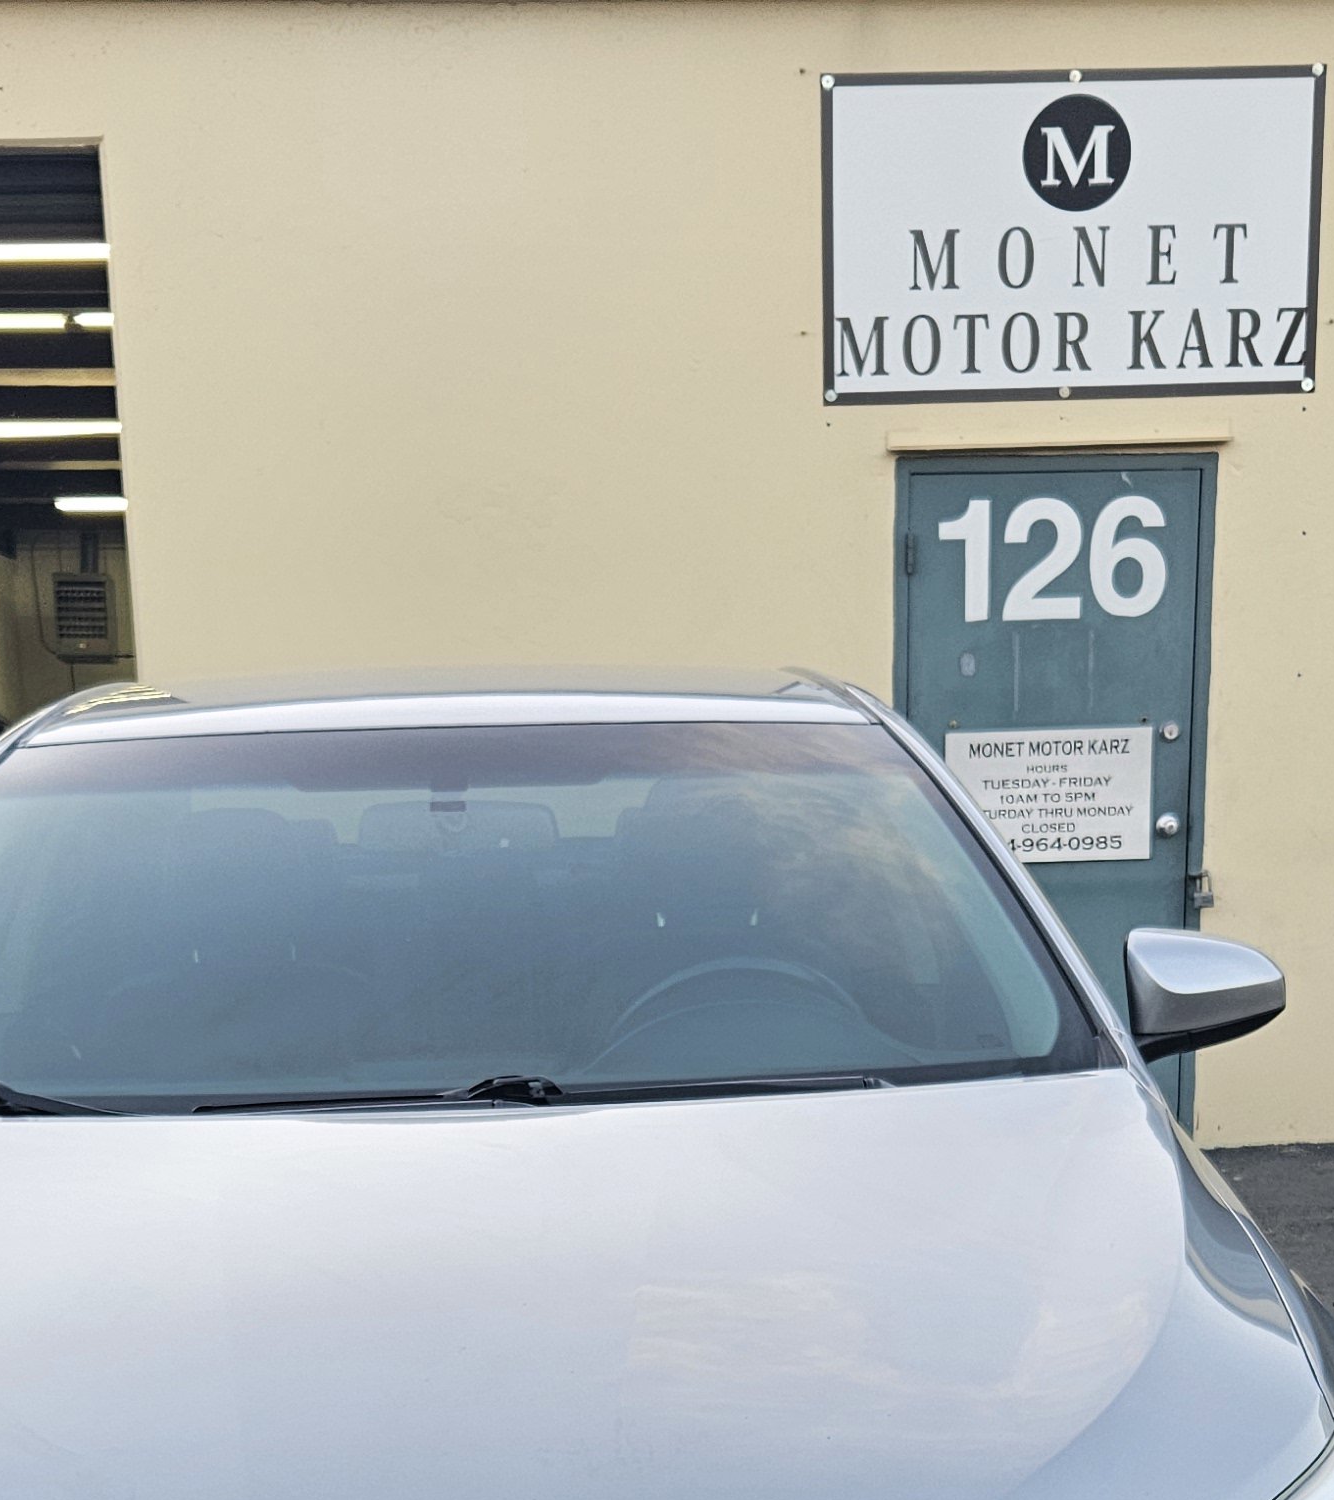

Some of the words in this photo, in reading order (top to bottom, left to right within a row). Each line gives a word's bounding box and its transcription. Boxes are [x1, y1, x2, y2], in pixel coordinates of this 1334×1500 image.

[1040, 125, 1115, 187] M
[909, 223, 1248, 291] MONET
[835, 312, 1091, 377] MOTOR
[1127, 306, 1309, 370] KARZ
[938, 495, 1168, 622] 126
[969, 742, 1024, 759] MONET
[1028, 740, 1083, 757] MOTOR
[1088, 739, 1131, 755] KARZ
[1027, 764, 1068, 774] HOURS
[1000, 794, 1037, 804] 10AM
[1042, 793, 1061, 803] TO
[1065, 792, 1096, 802] 5PM
[982, 809, 1033, 820] TURDAY
[1038, 807, 1073, 818] THRU
[1077, 805, 1134, 817] MONDAY
[1022, 823, 1075, 834] CLOSED
